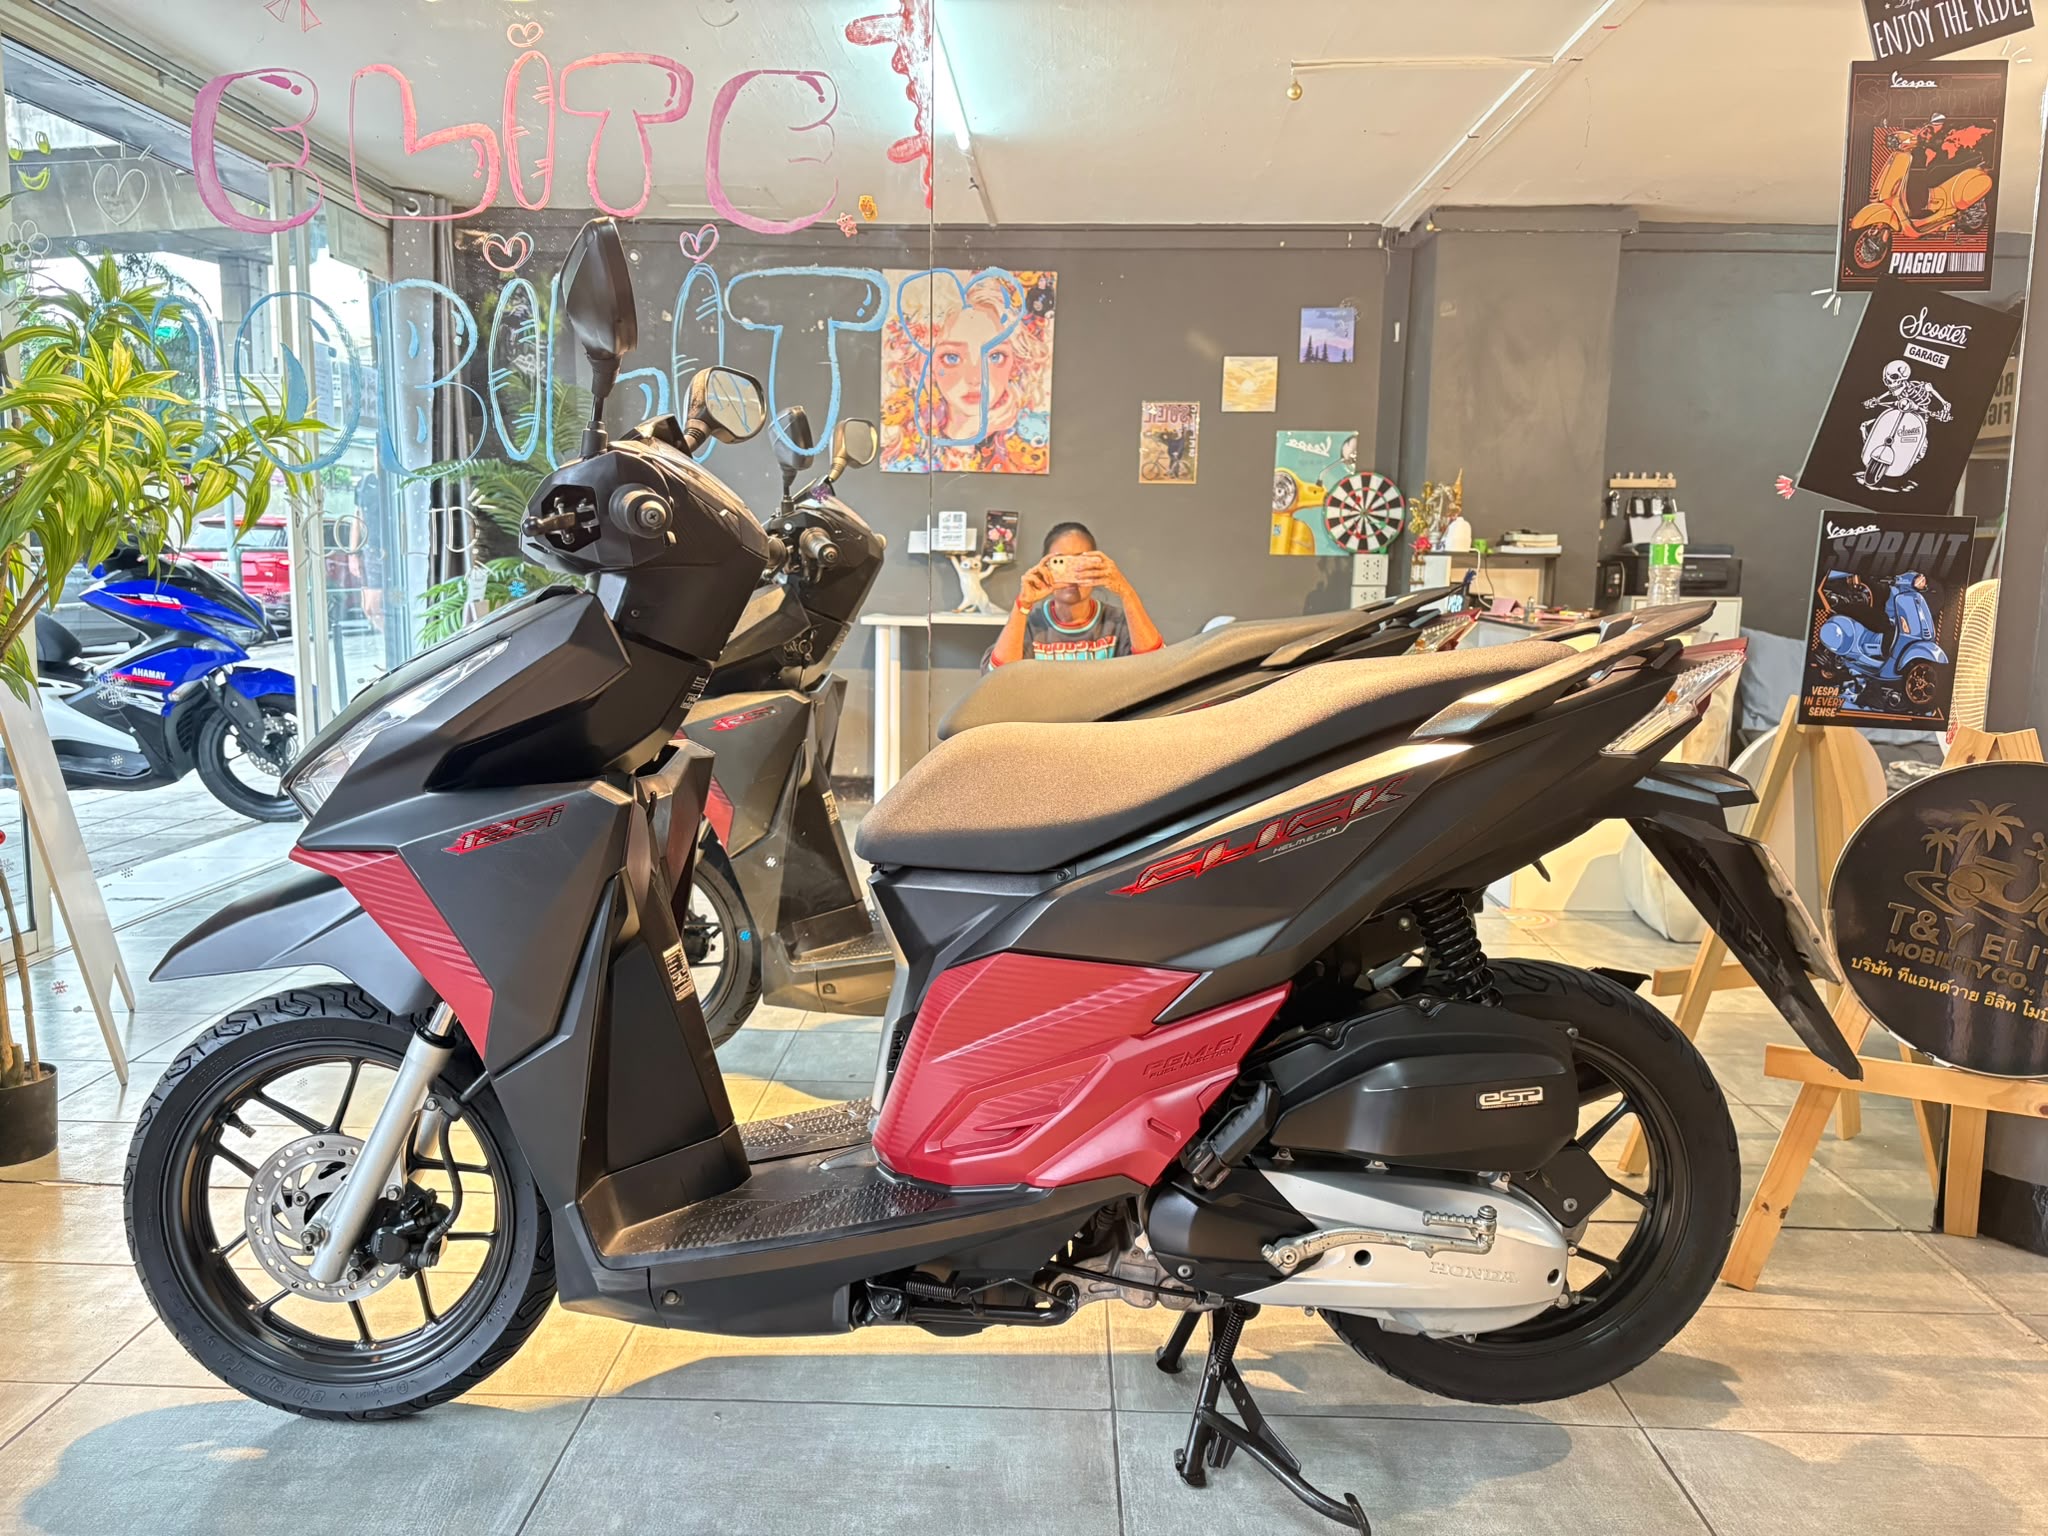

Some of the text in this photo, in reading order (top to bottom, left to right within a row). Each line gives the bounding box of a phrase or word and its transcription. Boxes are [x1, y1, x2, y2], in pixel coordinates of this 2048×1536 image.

[1873, 7, 1935, 59] ENJOY
[1935, 0, 1974, 38] THE
[1890, 71, 1938, 88] Vespa
[1889, 251, 1947, 274] PIAGGIO
[1899, 306, 1973, 346] Scooter
[1908, 346, 1945, 365] GARAGE
[1826, 520, 1880, 539] Vespa
[1824, 531, 1969, 577] SPRINT
[1803, 696, 1844, 707] IN EVERY
[1811, 685, 1839, 696] VESPA
[1808, 707, 1837, 717] SENSE
[1130, 773, 1412, 894] CLICK
[1272, 826, 1338, 854] HELMET-IN
[1887, 902, 1975, 950] T&Y
[1850, 955, 1893, 979] บริษัท
[1885, 938, 1993, 980] MOBILITY
[1429, 1260, 1520, 1284] HONDA
